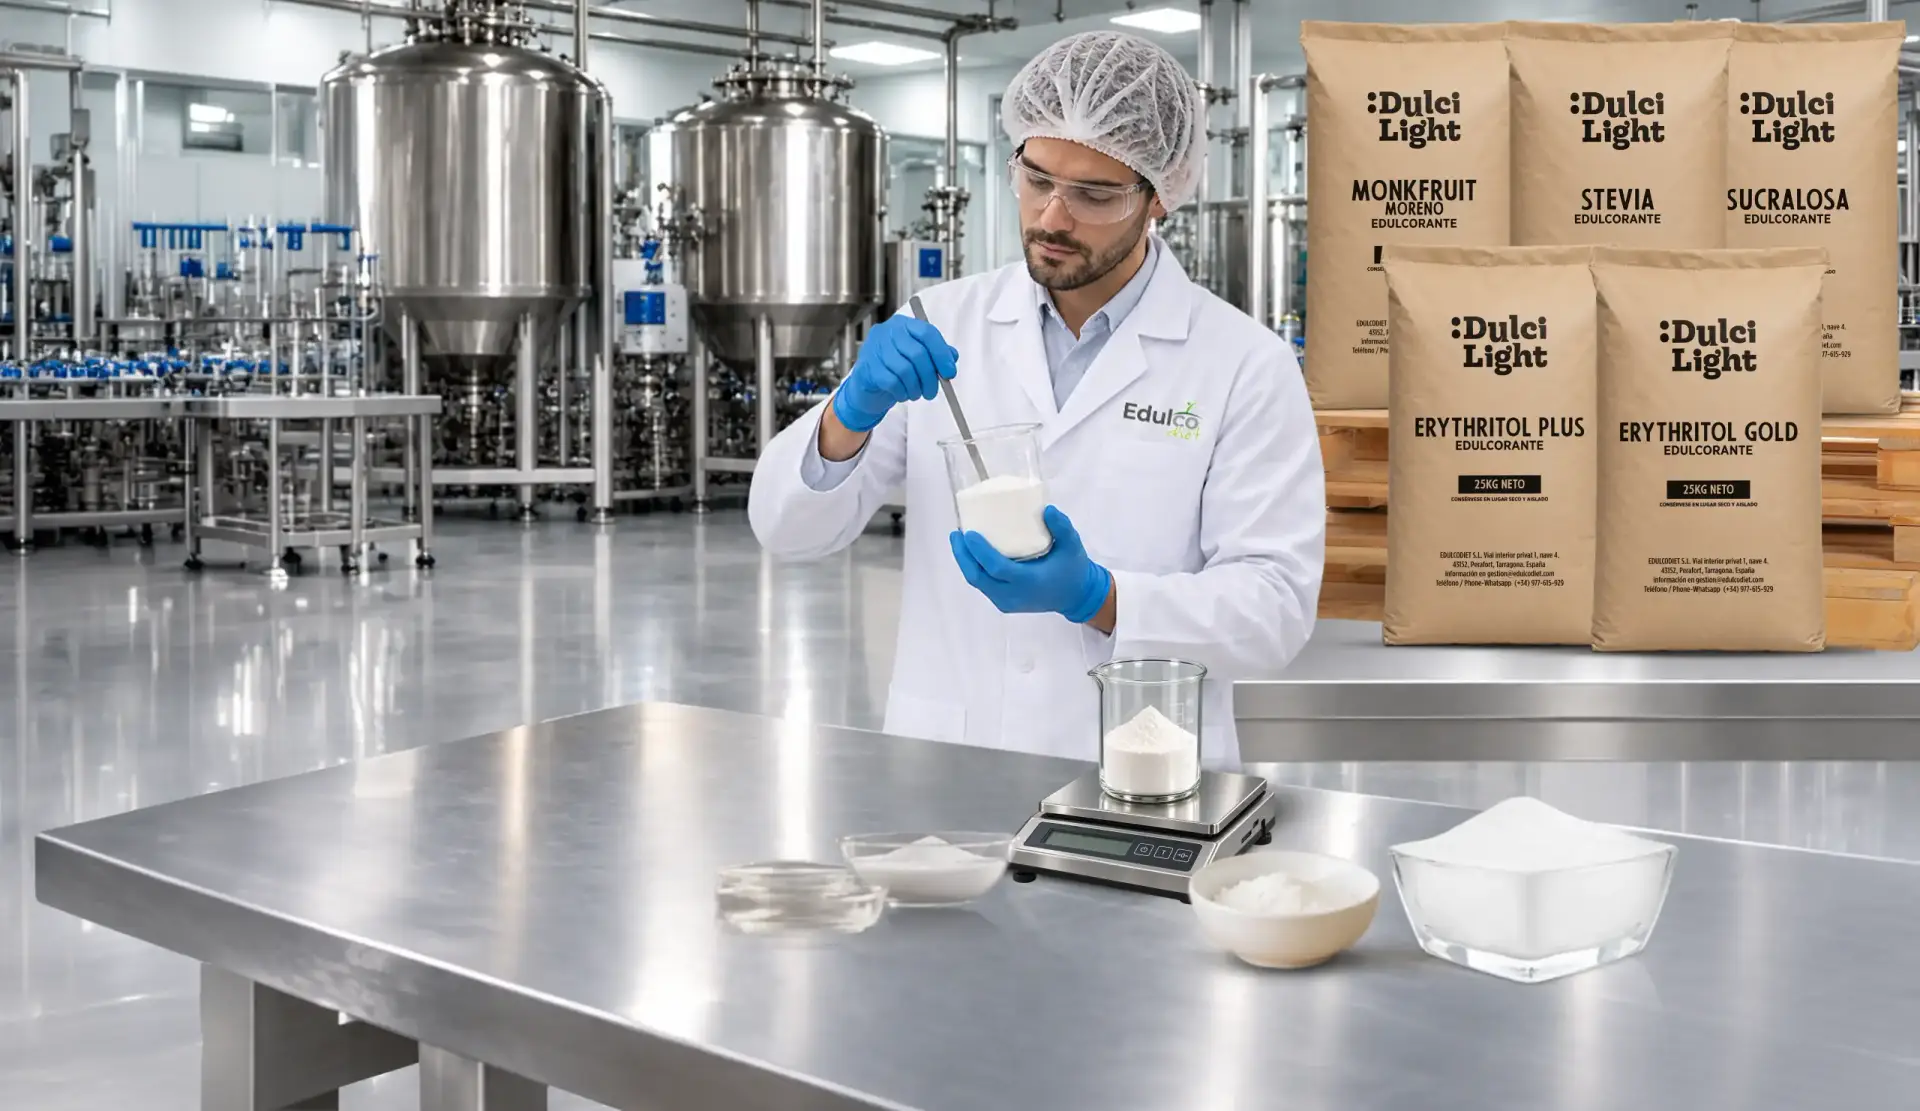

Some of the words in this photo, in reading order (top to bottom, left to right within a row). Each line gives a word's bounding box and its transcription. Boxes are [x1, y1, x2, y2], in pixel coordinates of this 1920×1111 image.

[1379, 117, 1461, 149] Light
[1582, 117, 1665, 150] Light
[1752, 117, 1835, 150] Light
[1351, 179, 1477, 201] MONKFRUIT
[1581, 188, 1655, 211] STEVIA
[1727, 188, 1850, 211] SUCRALOSA
[1385, 201, 1444, 216] MORENO
[1371, 218, 1458, 228] EDULCORANTE
[1574, 213, 1661, 225] EDULCORANTE
[1744, 213, 1831, 225] EDULCORANTE
[1464, 343, 1548, 376] Light
[1672, 347, 1757, 380] Light
[1123, 402, 1199, 430] Edulco
[1414, 416, 1532, 438] ERYTHRITOL
[1538, 416, 1585, 438] PLUS
[1619, 421, 1737, 443] ERYTHRITOL
[1744, 421, 1798, 443] GOLD
[1455, 440, 1544, 451] EDULCORANTE
[1663, 445, 1753, 456] EDULCORANTE
[1474, 478, 1498, 490] 25KG
[1501, 478, 1526, 490] NETO
[1683, 484, 1707, 495] 25KG
[1710, 484, 1735, 495] NETO
[1440, 551, 1472, 559] EDULCODIET
[1483, 551, 1494, 559] Vial
[1495, 551, 1516, 559] interior
[1540, 551, 1553, 559] nave
[1648, 557, 1680, 565] EDULCODIET
[1692, 557, 1703, 565] Vial
[1704, 557, 1724, 565] interior
[1749, 557, 1762, 565] nave
[1526, 560, 1546, 569] España
[1735, 566, 1755, 575] España
[1464, 579, 1512, 588] Phone-Whatsapp
[1514, 579, 1530, 588] (+34)
[1530, 579, 1564, 588] 977-615-929
[1672, 585, 1721, 593] Phone-Whatsapp
[1723, 585, 1739, 593] (+34)
[1740, 585, 1774, 593] 977-615-929
